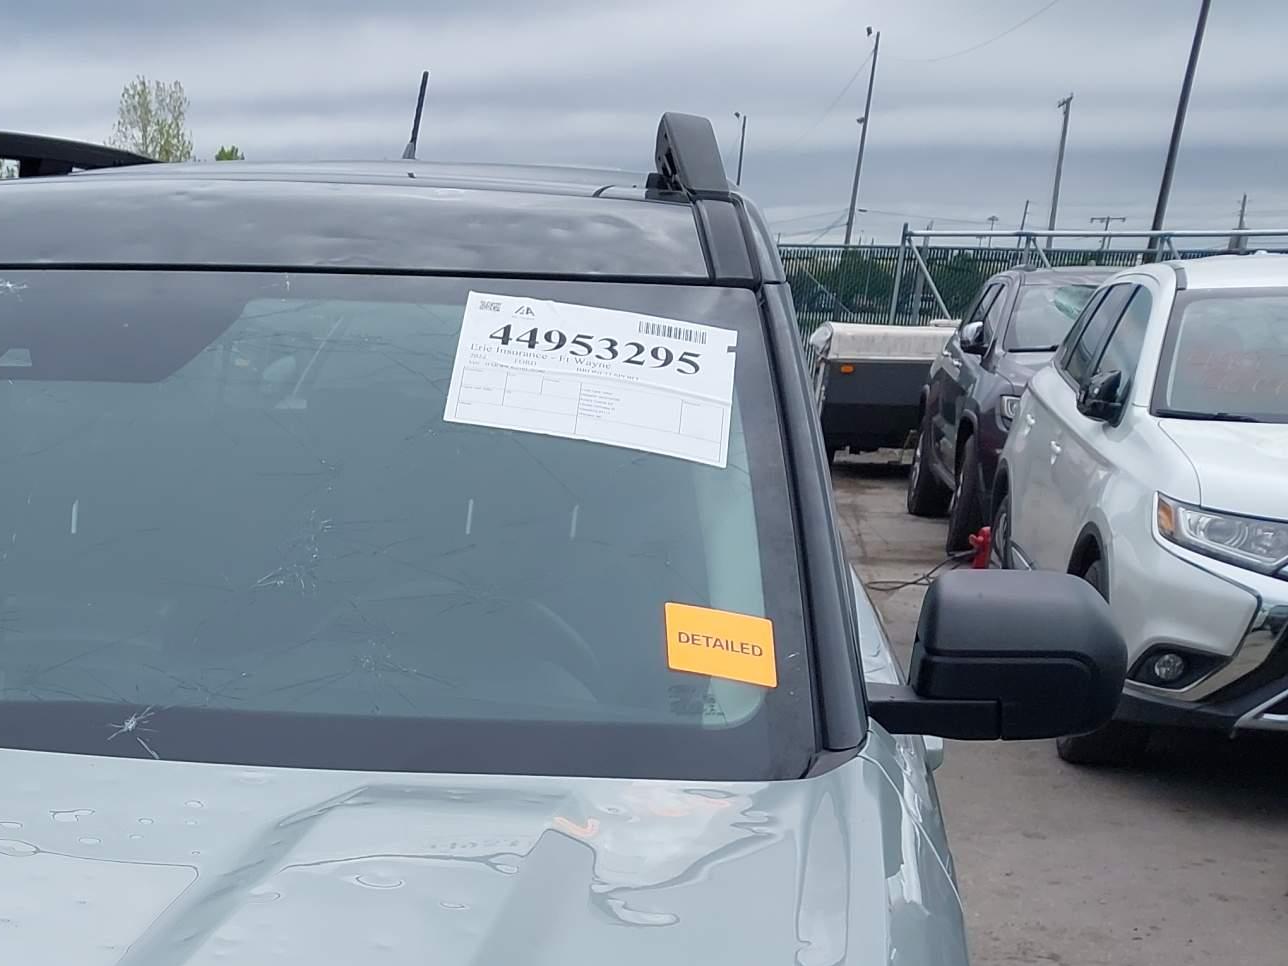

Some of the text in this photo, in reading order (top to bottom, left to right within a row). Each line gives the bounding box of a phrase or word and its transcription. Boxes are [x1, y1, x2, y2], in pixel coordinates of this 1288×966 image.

[470, 343, 493, 353] Erie
[496, 346, 548, 361] Insurance
[574, 356, 612, 370] Wayne
[489, 323, 702, 375] 44953295
[678, 631, 763, 657] DETAILED
